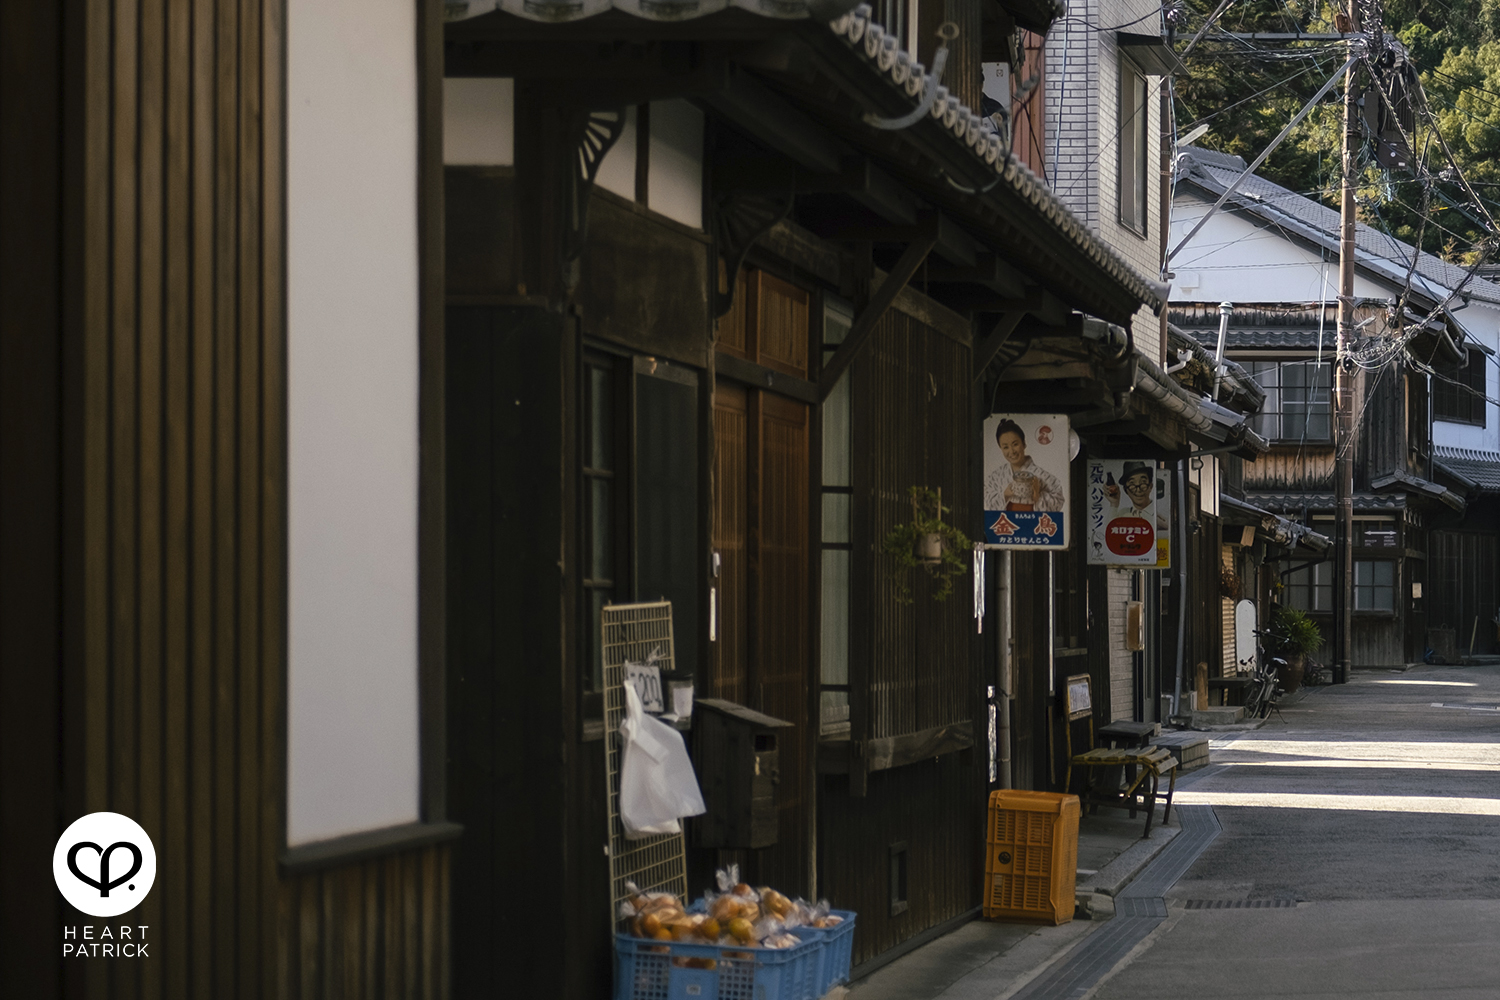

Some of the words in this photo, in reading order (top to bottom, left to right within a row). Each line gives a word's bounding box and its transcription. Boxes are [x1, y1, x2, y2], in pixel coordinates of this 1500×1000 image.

[1111, 526, 1150, 535] オロナミン
[1125, 534, 1135, 543] C
